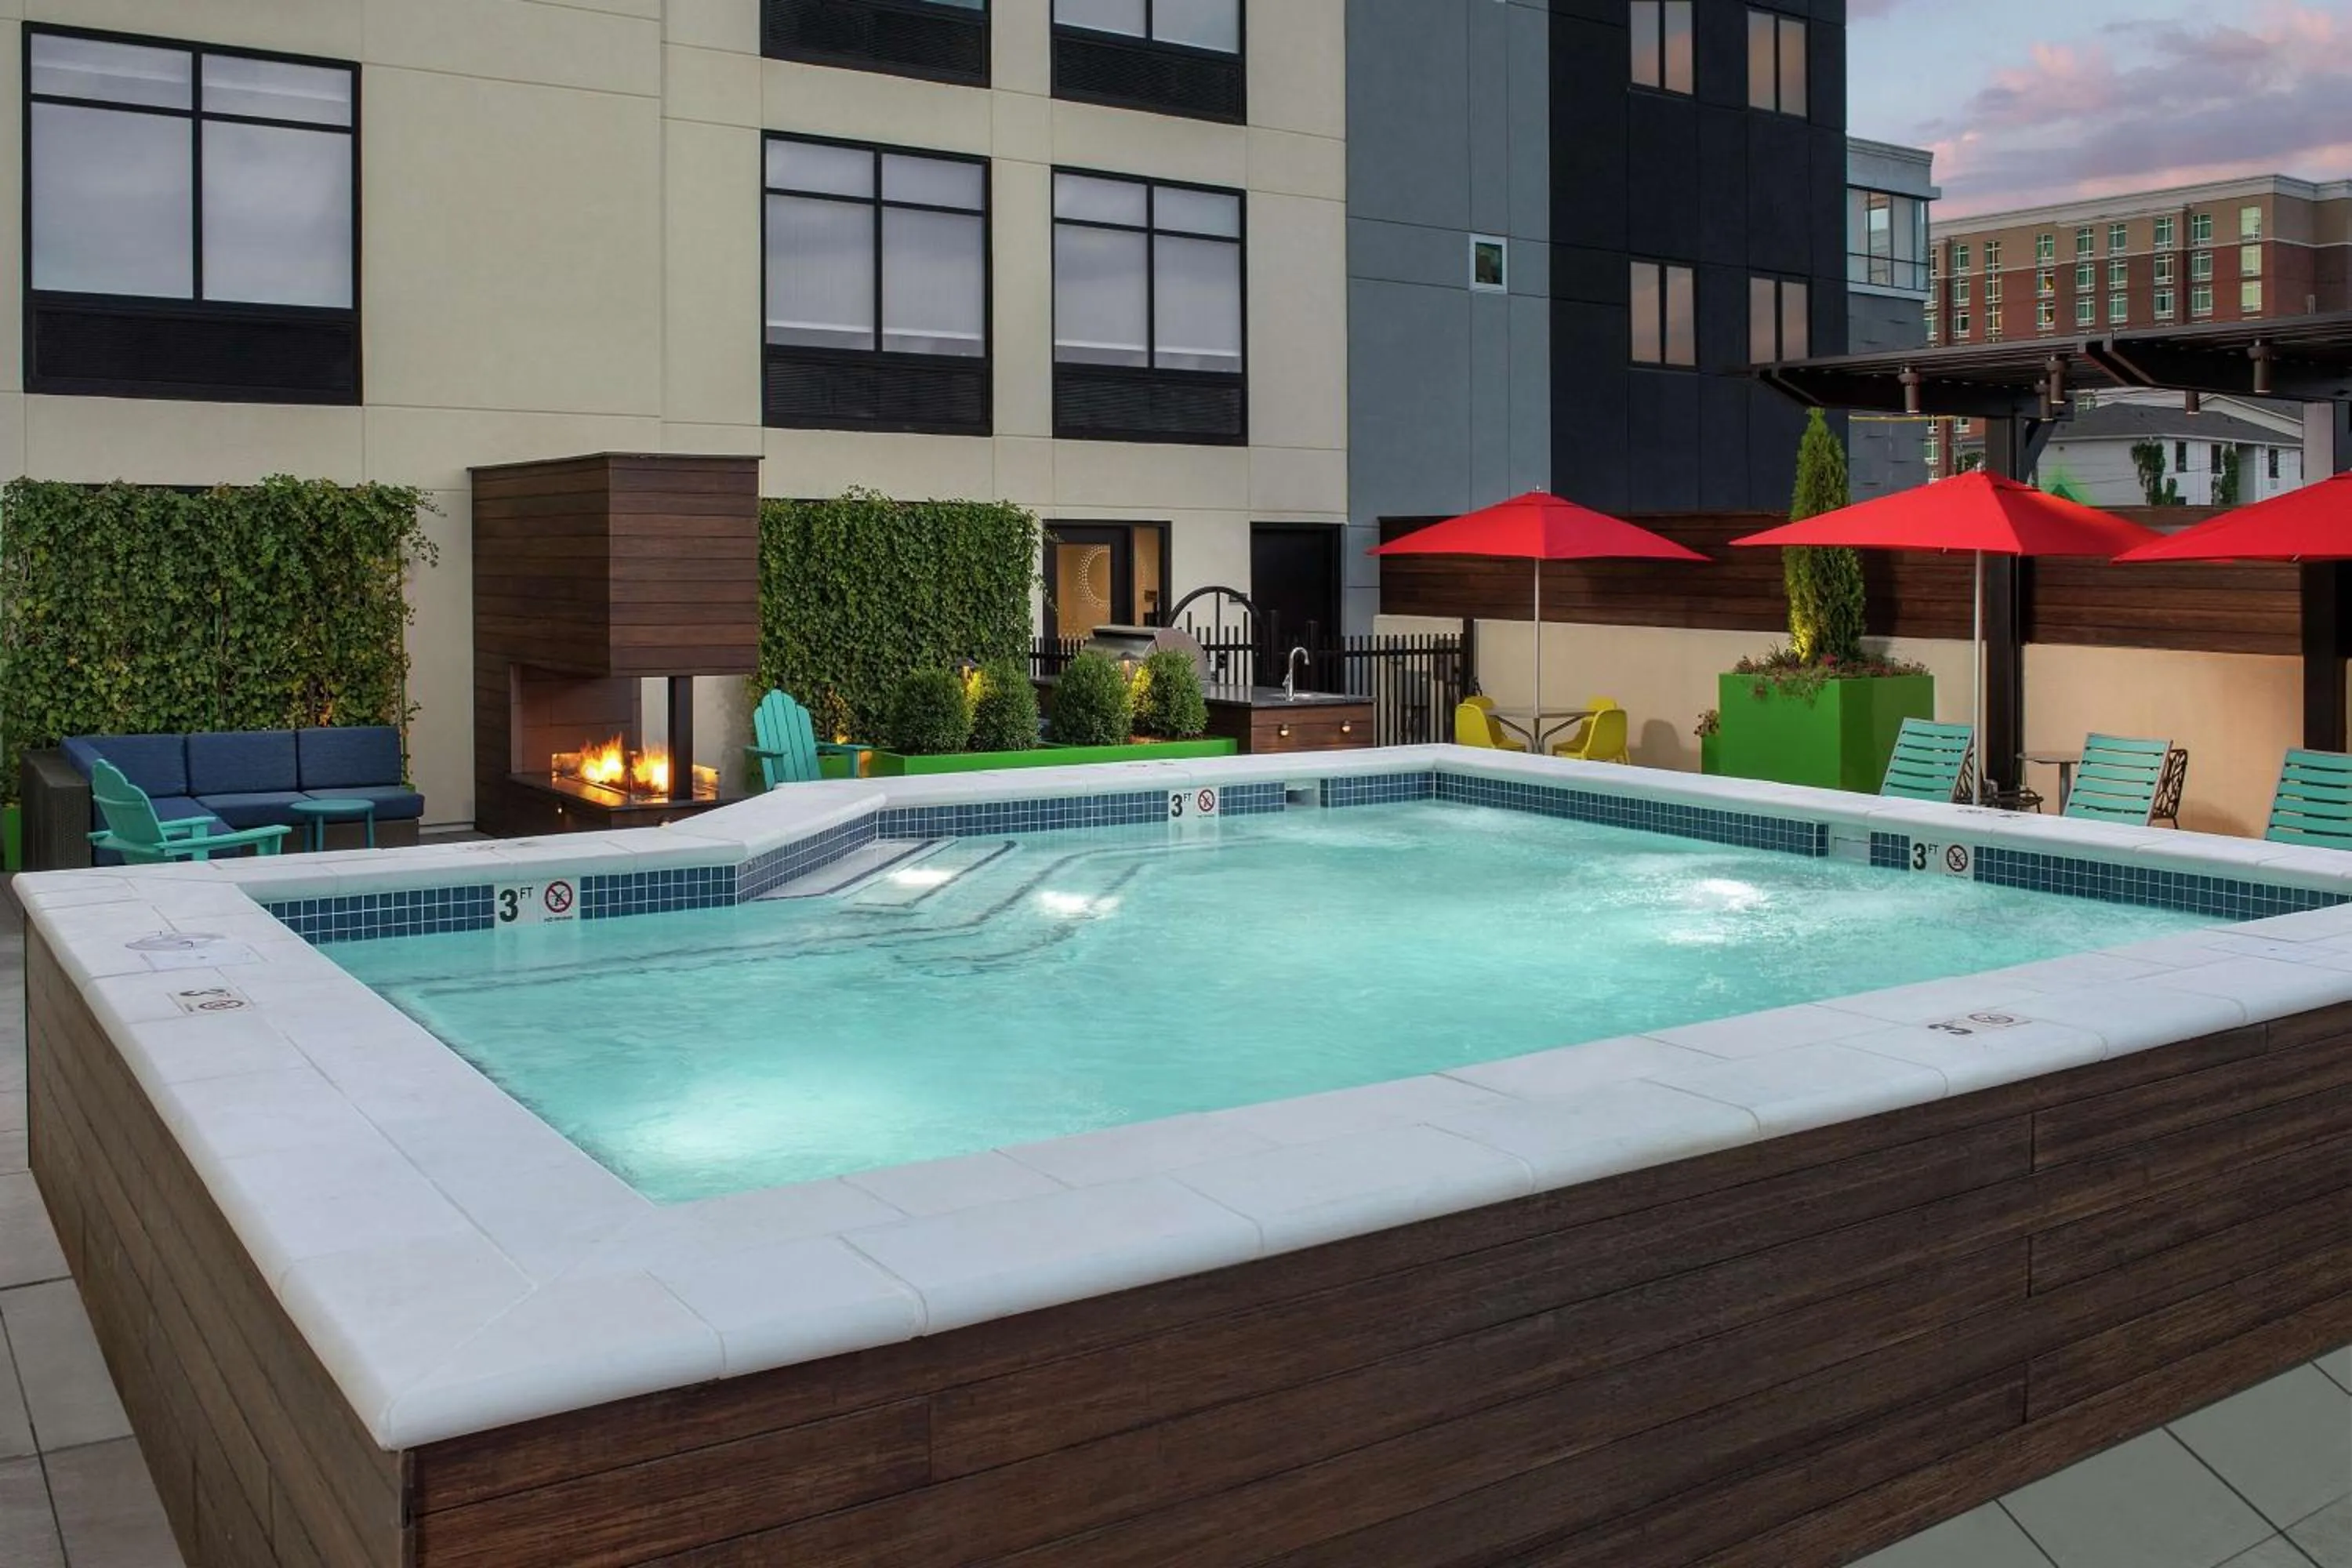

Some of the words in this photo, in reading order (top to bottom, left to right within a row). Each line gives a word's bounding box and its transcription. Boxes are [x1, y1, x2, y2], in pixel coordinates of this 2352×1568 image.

[1171, 793, 1183, 817] 3
[1183, 793, 1192, 802] FT
[1913, 843, 1927, 870] 3
[1929, 844, 1940, 855] FT
[499, 889, 518, 922] 3
[520, 887, 534, 899] FT
